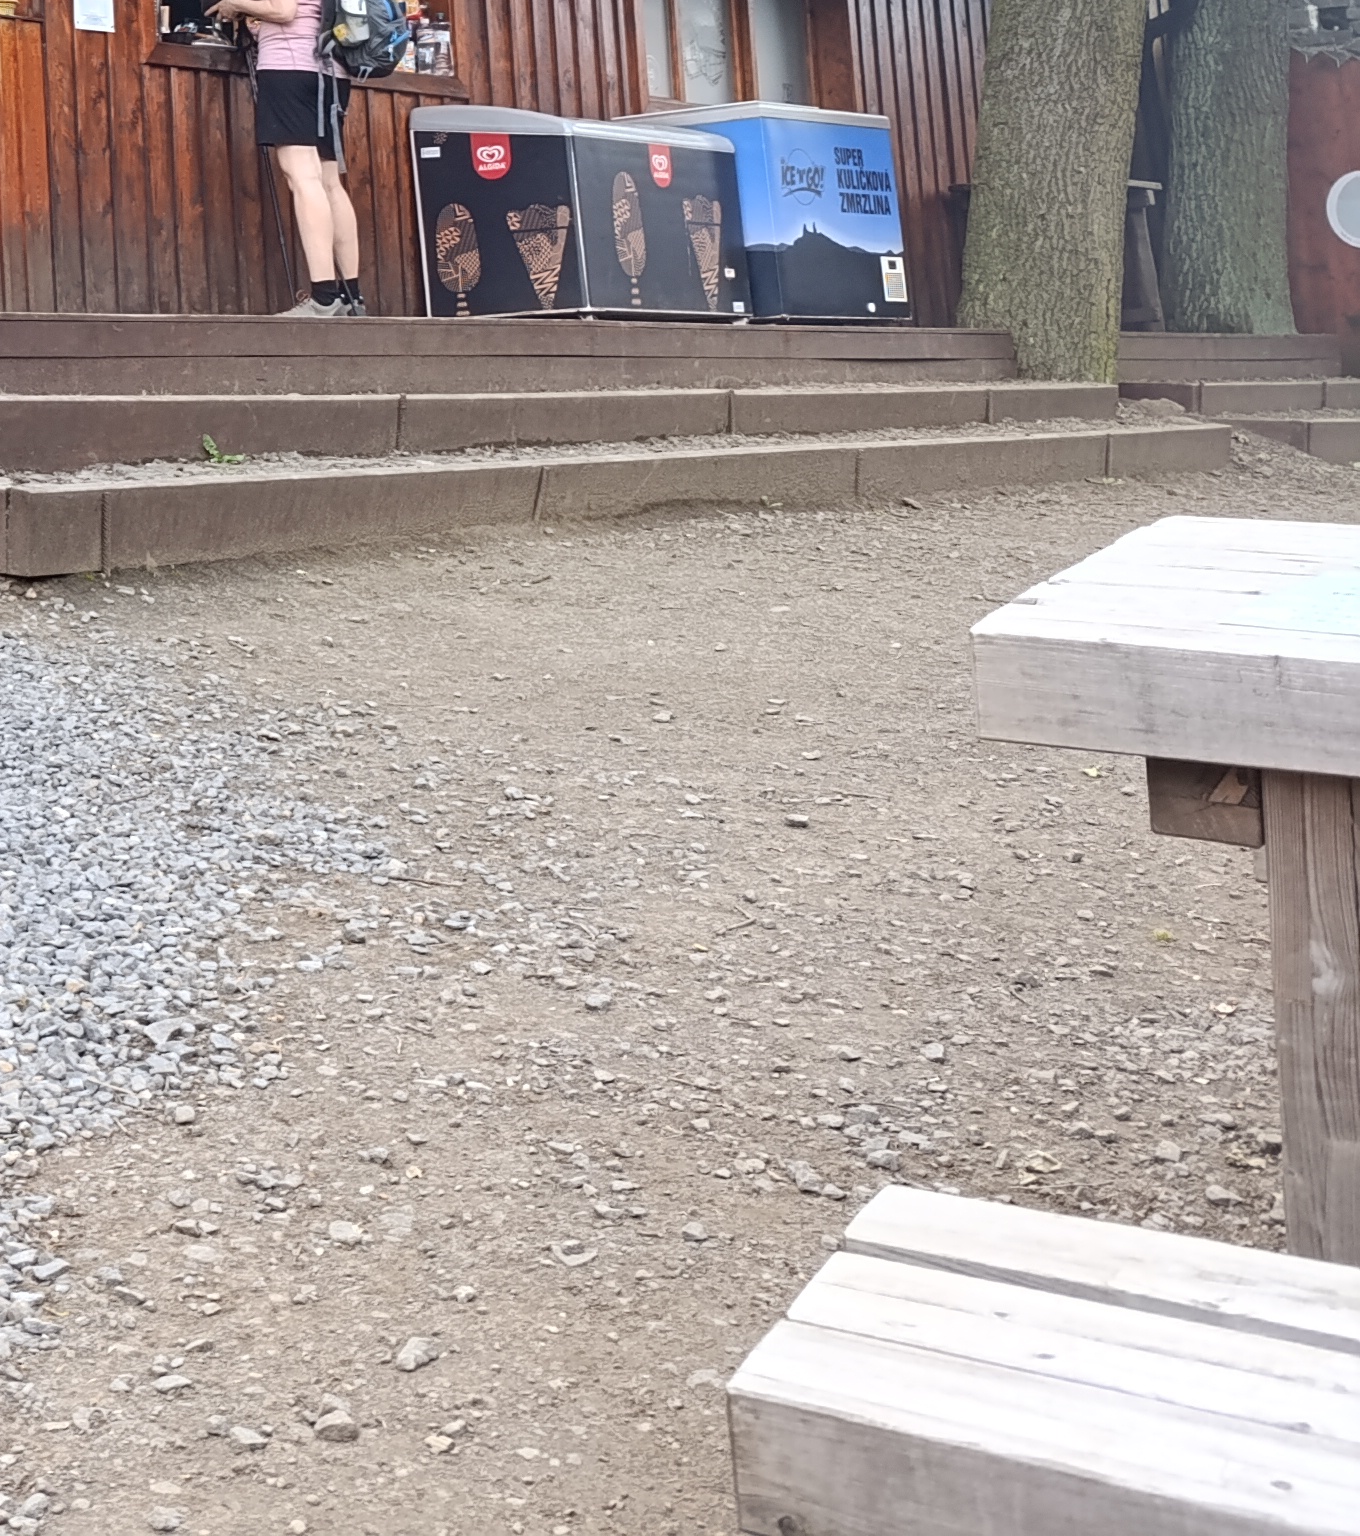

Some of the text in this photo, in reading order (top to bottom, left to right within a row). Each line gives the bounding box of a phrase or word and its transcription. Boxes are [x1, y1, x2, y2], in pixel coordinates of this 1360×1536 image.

[478, 161, 507, 171] ALGIDA
[834, 146, 864, 167] SUPER
[806, 166, 825, 189] GO!
[836, 167, 892, 192] KULIČKOVÁ
[839, 192, 891, 215] ZMRZLINA
